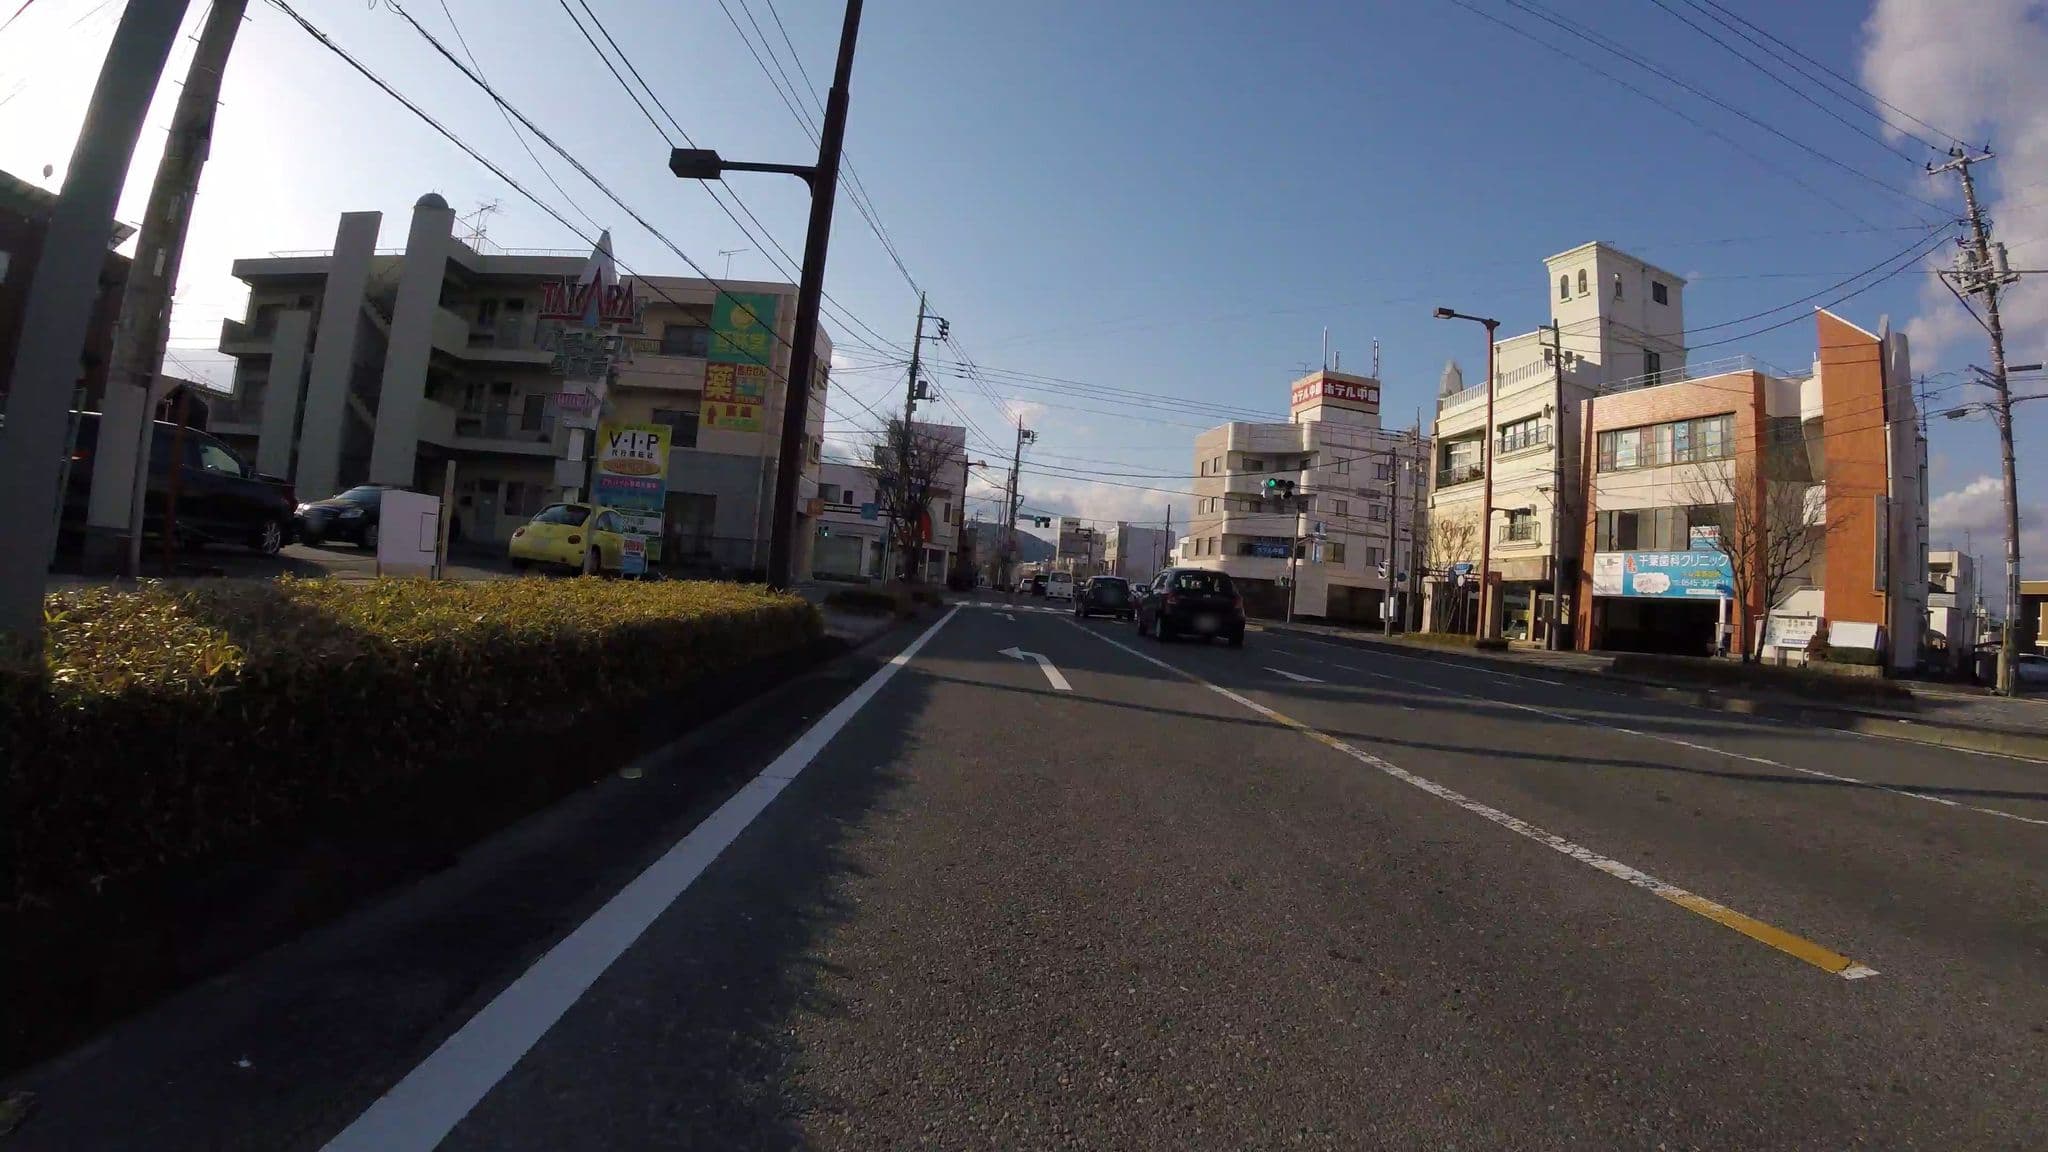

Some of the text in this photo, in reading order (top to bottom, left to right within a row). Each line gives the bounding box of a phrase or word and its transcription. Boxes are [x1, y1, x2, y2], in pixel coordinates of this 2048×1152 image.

[706, 364, 734, 397] 薬
[1638, 553, 1730, 568] 千葉歯科クリニック
